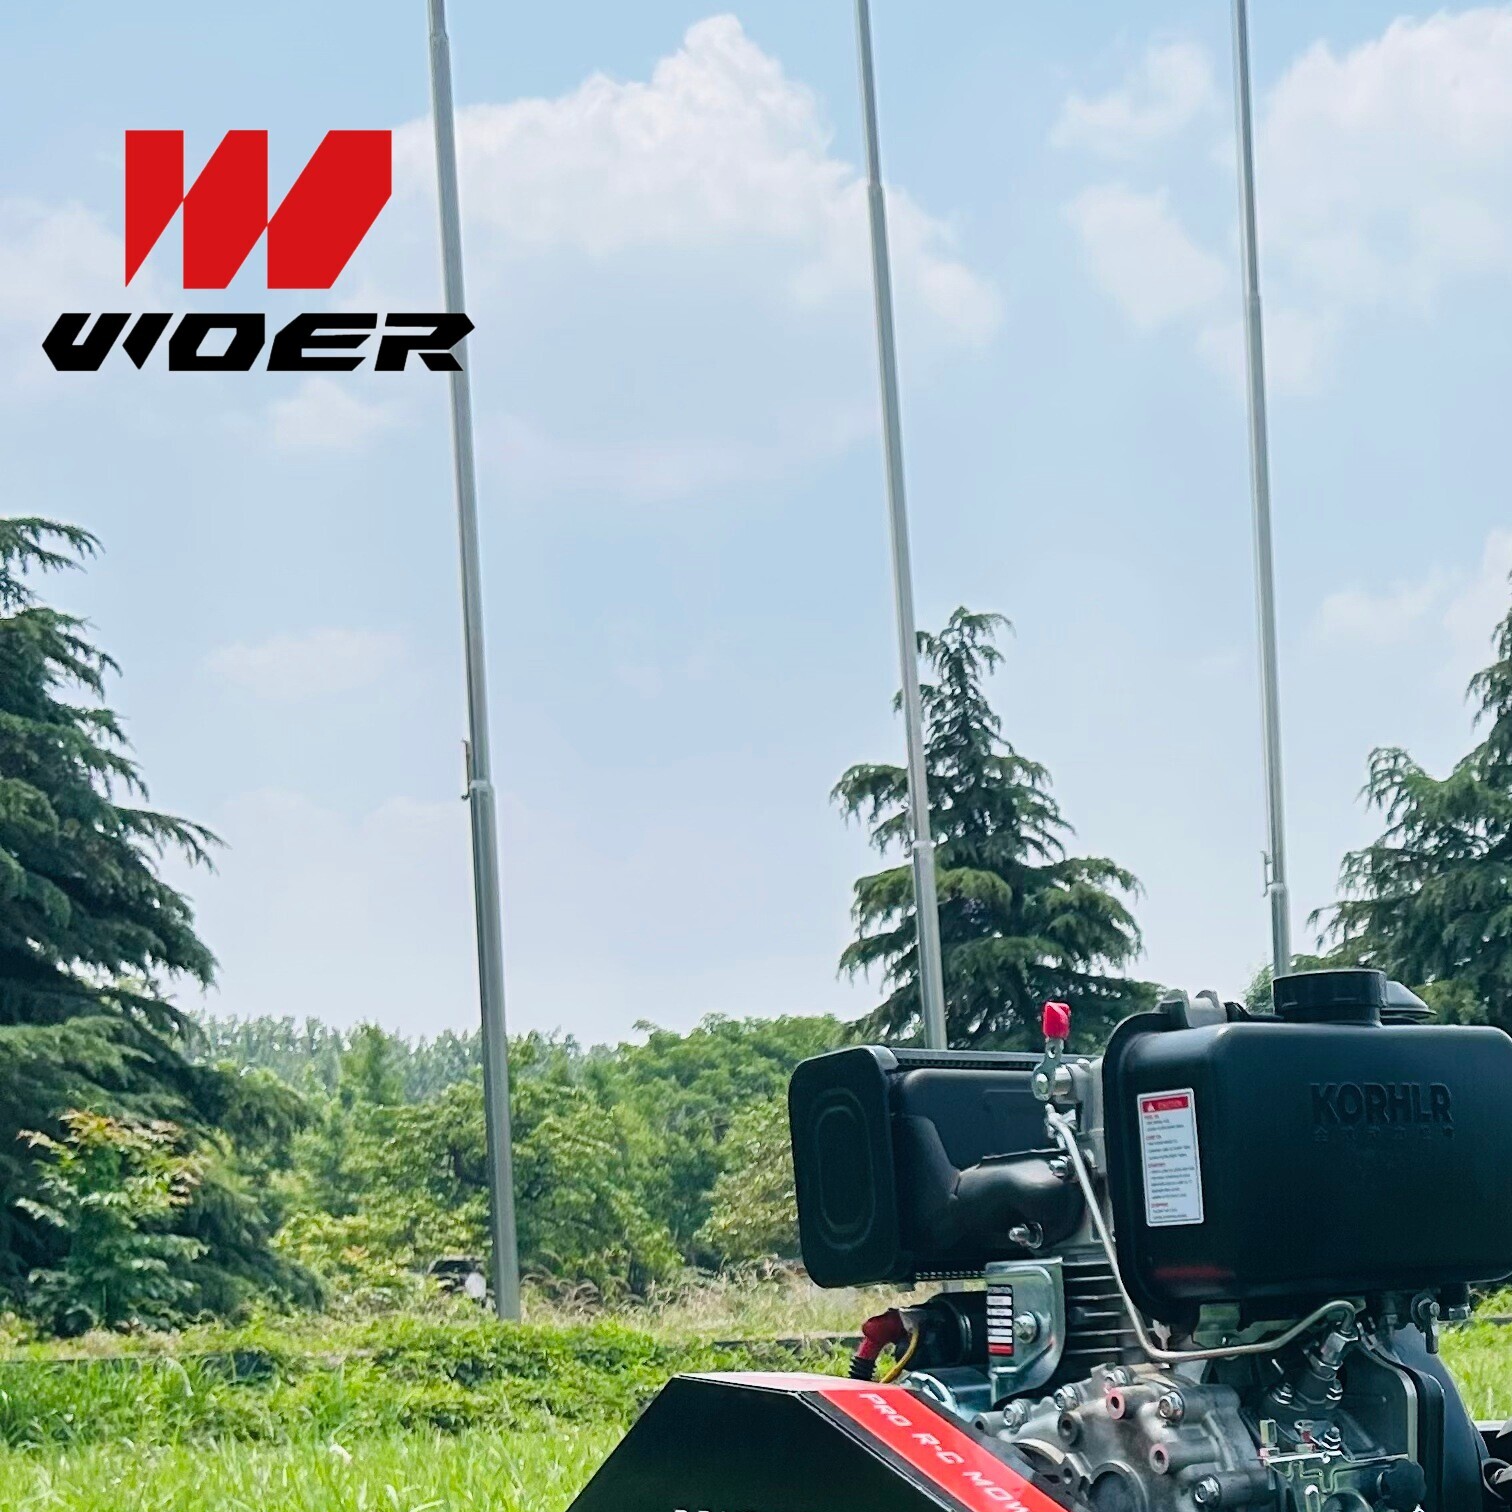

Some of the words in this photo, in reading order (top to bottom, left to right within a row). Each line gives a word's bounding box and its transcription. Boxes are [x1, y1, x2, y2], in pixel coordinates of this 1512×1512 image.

[1310, 1082, 1454, 1123] KORHLR
[859, 1393, 913, 1427] PRO
[912, 1432, 965, 1464] R-C
